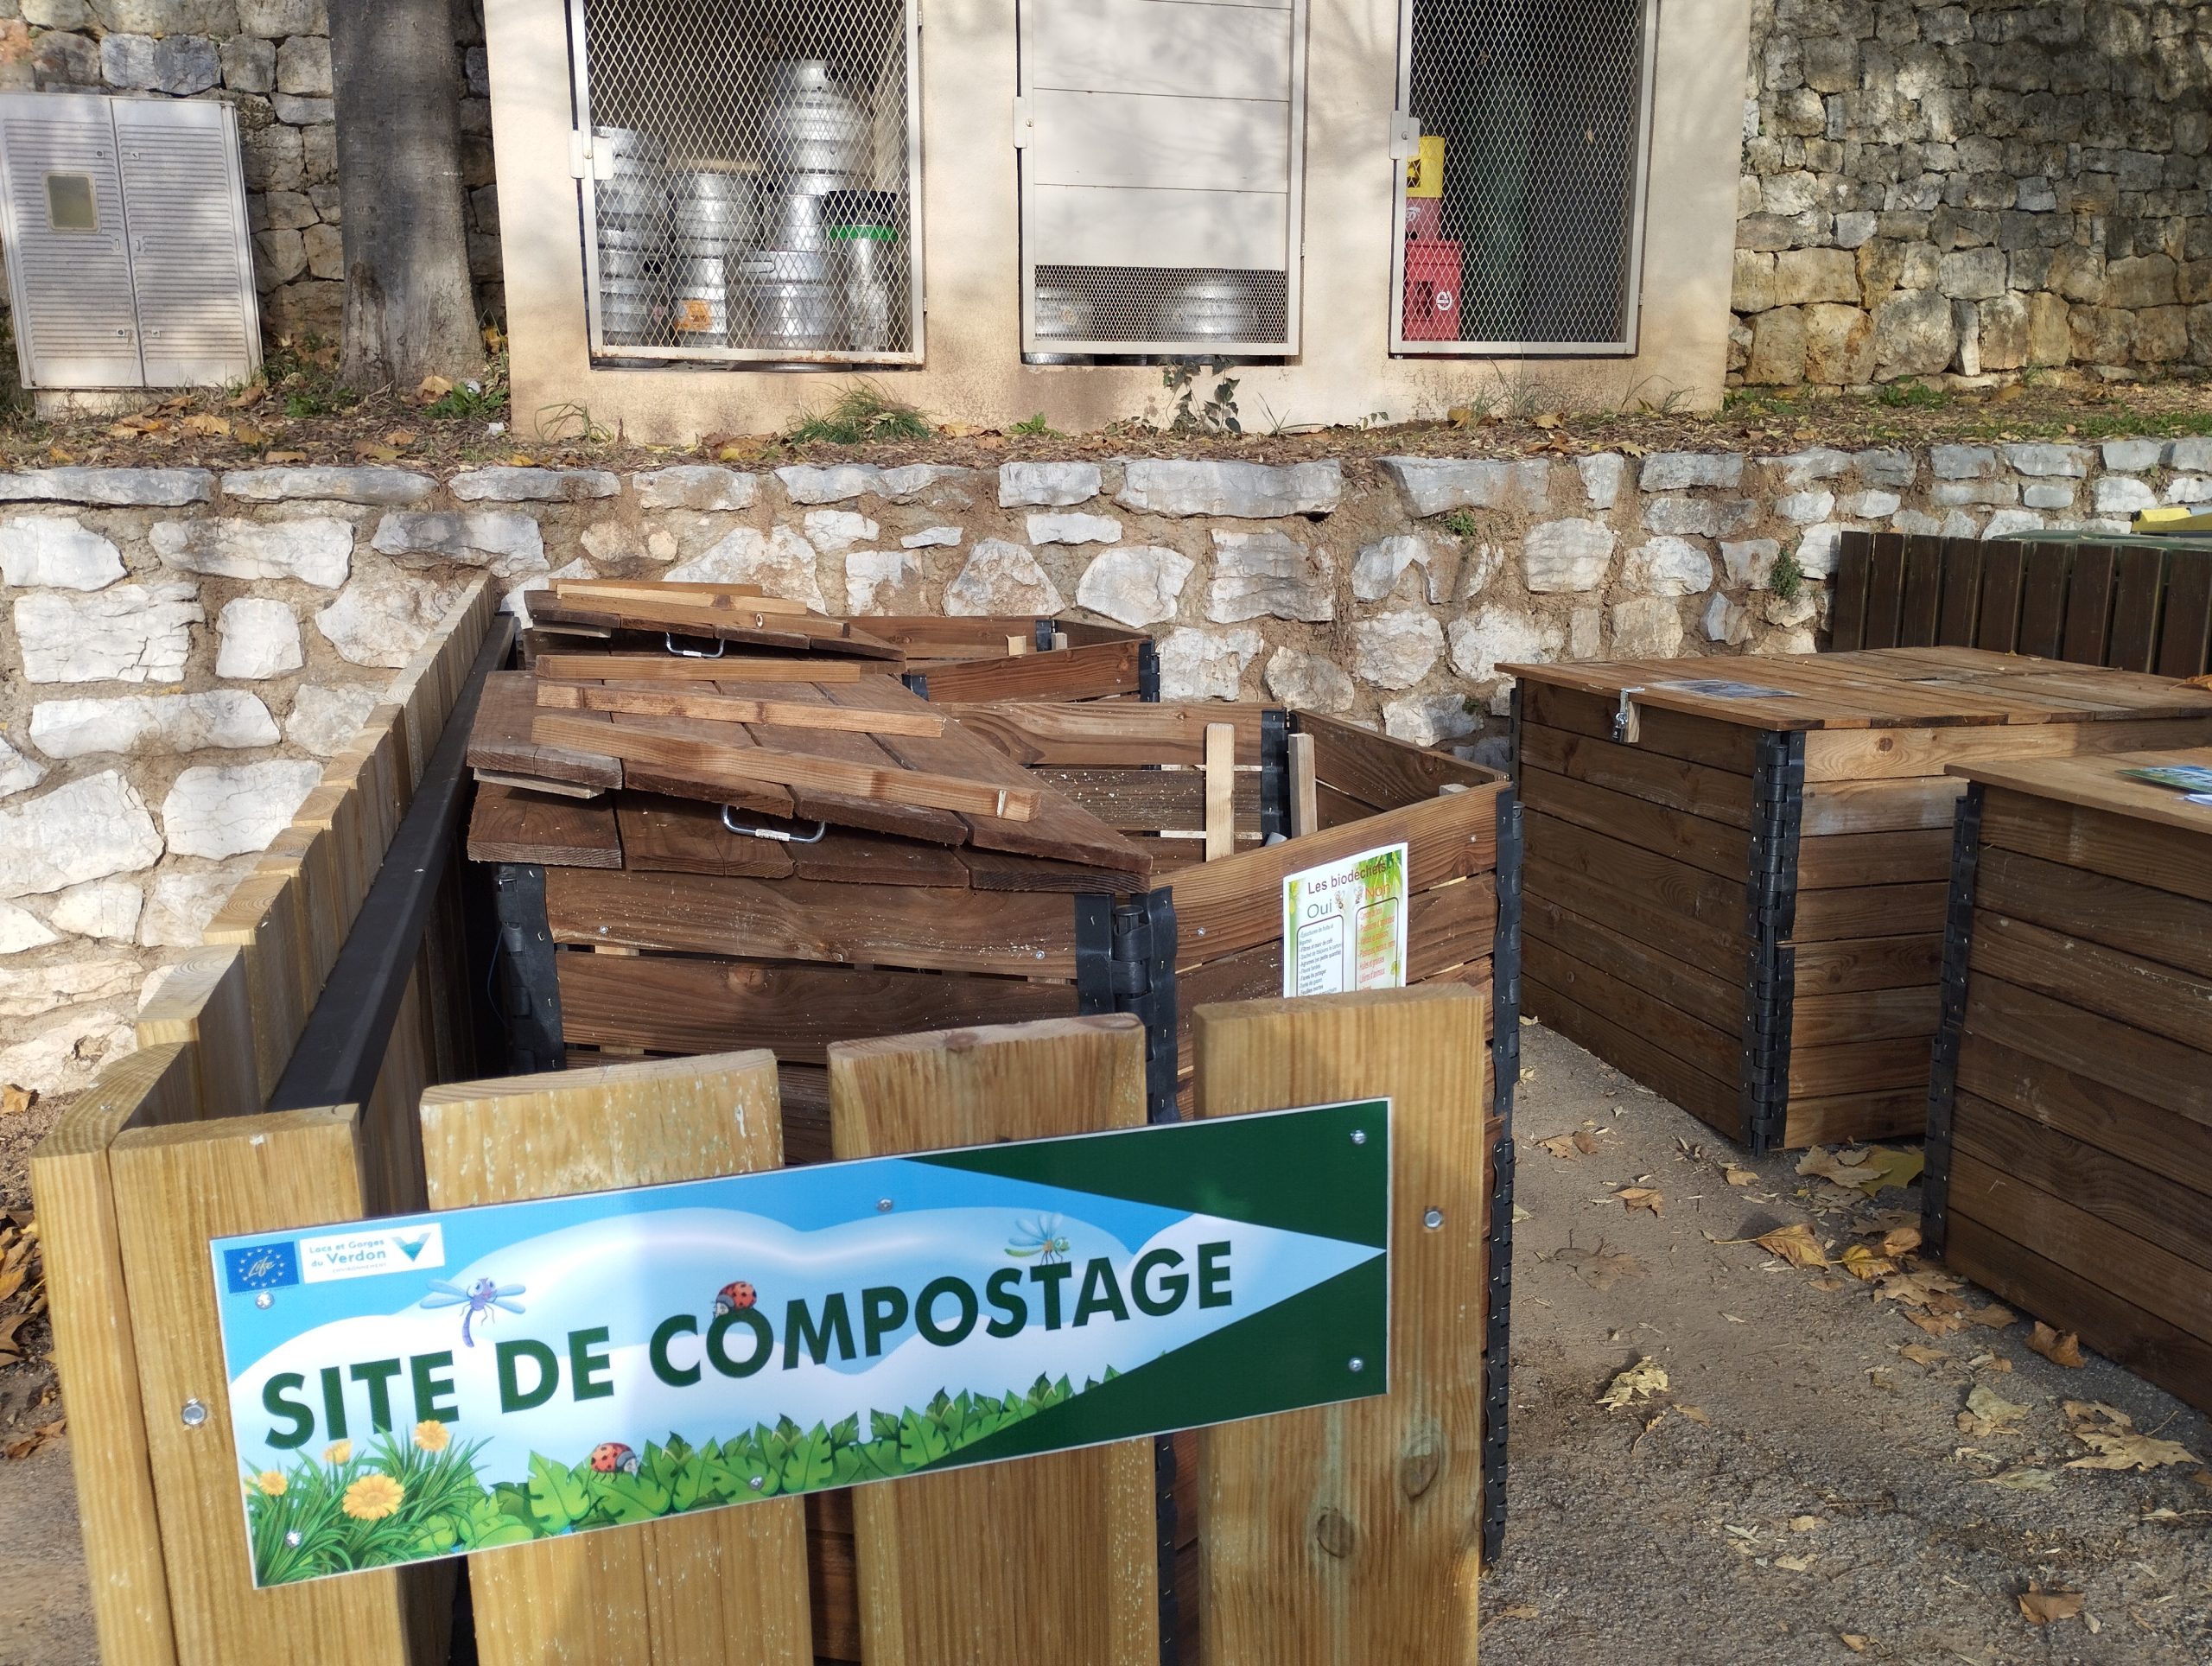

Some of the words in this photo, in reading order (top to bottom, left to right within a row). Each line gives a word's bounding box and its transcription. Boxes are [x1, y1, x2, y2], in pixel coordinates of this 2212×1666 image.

[1307, 880, 1327, 895] Les
[1331, 861, 1387, 888] biodéchets
[1365, 883, 1391, 900] Non
[1307, 899, 1332, 919] Oui
[309, 1245, 333, 1254] Lacs
[348, 1239, 385, 1249] Gorges
[248, 1256, 276, 1277] Life
[311, 1259, 324, 1268] du
[326, 1250, 386, 1264] Verdon
[264, 1352, 461, 1450] SITE
[498, 1326, 614, 1412] DE
[649, 1240, 1234, 1389] COMPOSTAGE
